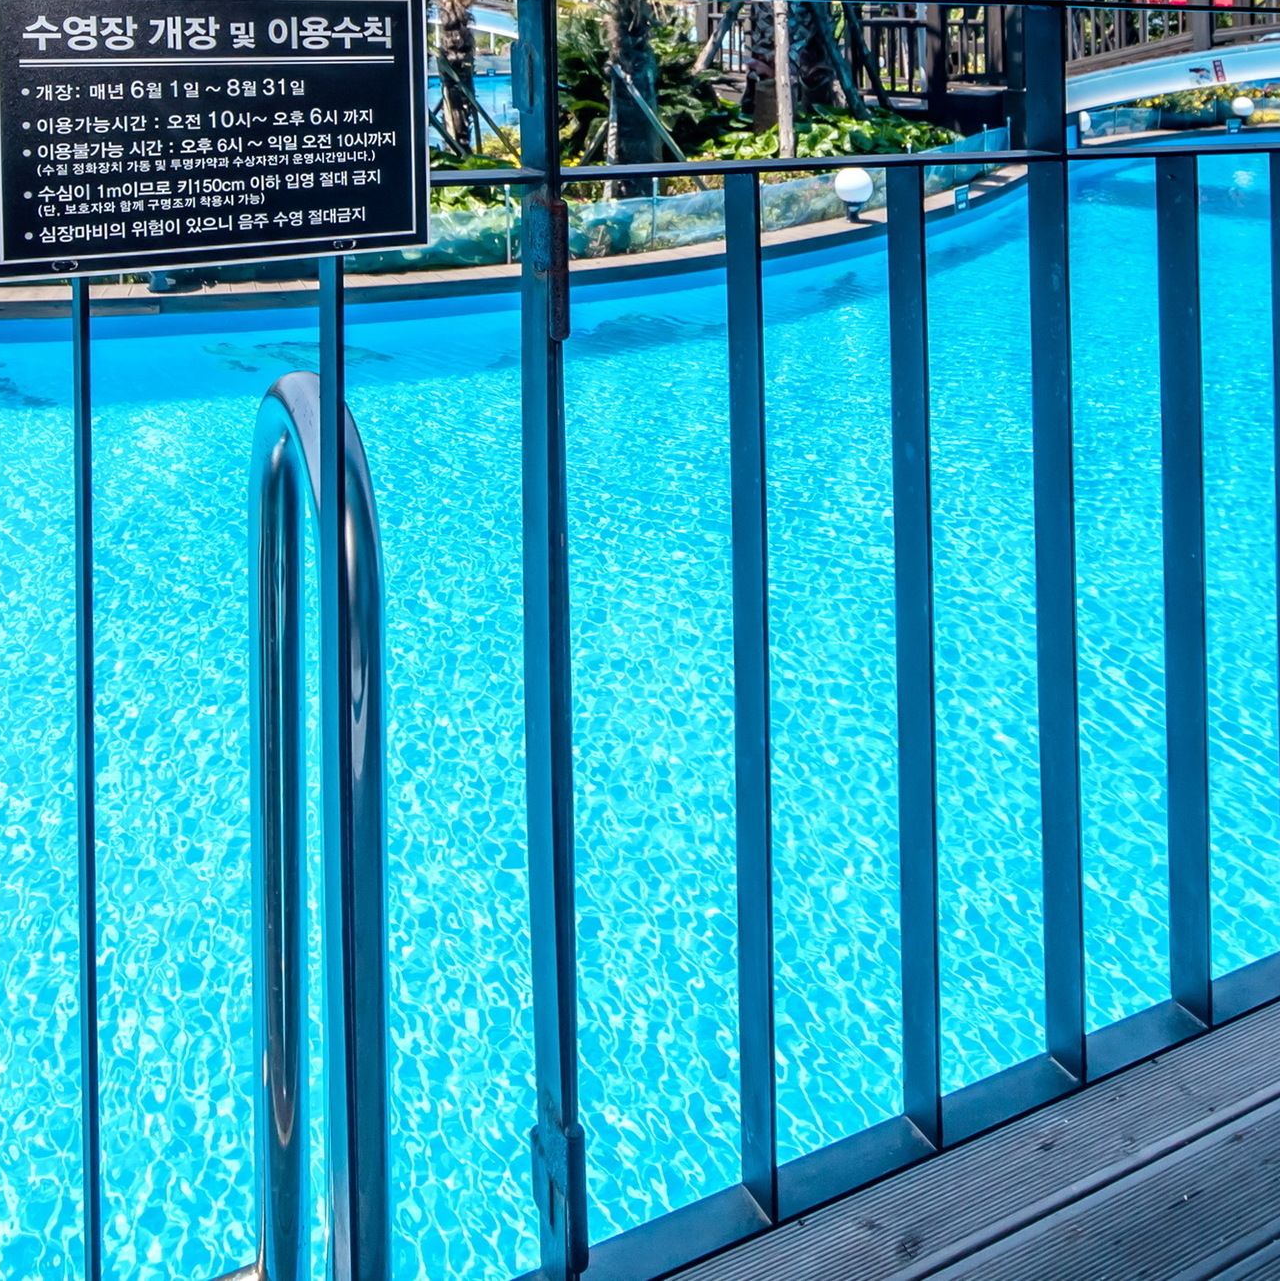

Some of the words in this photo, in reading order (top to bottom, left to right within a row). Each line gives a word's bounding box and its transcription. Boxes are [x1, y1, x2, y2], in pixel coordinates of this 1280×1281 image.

[22, 15, 138, 51] 수영장
[148, 15, 220, 50] 개장
[230, 21, 256, 49] 및
[268, 16, 392, 49] 이용수칙
[36, 84, 80, 101] 개장:
[89, 83, 124, 100] 매년
[130, 80, 162, 99] 6월
[170, 80, 200, 98] 1일
[226, 78, 257, 97] 8월
[262, 78, 305, 96] 31일
[37, 115, 147, 134] 이용가능시간
[167, 113, 201, 130] 오전
[272, 110, 305, 126] 오후
[310, 108, 338, 125] 6시
[343, 108, 373, 124] 까지
[37, 142, 124, 161] 이용불가능
[129, 140, 163, 157] 시간
[180, 137, 213, 154] 오후
[217, 137, 243, 153] 6시
[267, 134, 297, 151] 익일
[301, 133, 332, 149] 오전
[337, 131, 396, 148] 10시까지
[37, 163, 68, 177] (수질
[72, 161, 122, 175] 정화장치
[127, 160, 151, 173] 가동
[155, 160, 166, 171] 및
[170, 156, 229, 170] 투명카약과
[232, 154, 289, 167] 수상자전거
[37, 184, 90, 202] 수심이
[97, 180, 172, 198] 1m이므로
[177, 177, 245, 195] 키150cm
[250, 174, 281, 191] 이하
[285, 172, 314, 189] 입영
[320, 171, 348, 187] 절대
[352, 169, 381, 186] 금지
[65, 202, 115, 215] 보호자와
[120, 200, 144, 212] 함께
[148, 197, 196, 211] 구명조끼
[200, 194, 234, 207] 착용시
[238, 193, 265, 206] 가능)
[39, 222, 125, 243] 심장마비의
[132, 219, 180, 237] 위험이
[186, 215, 232, 234] 있으니
[238, 213, 269, 230] 음주
[272, 210, 303, 228] 수영
[308, 206, 366, 225] 절대금지
